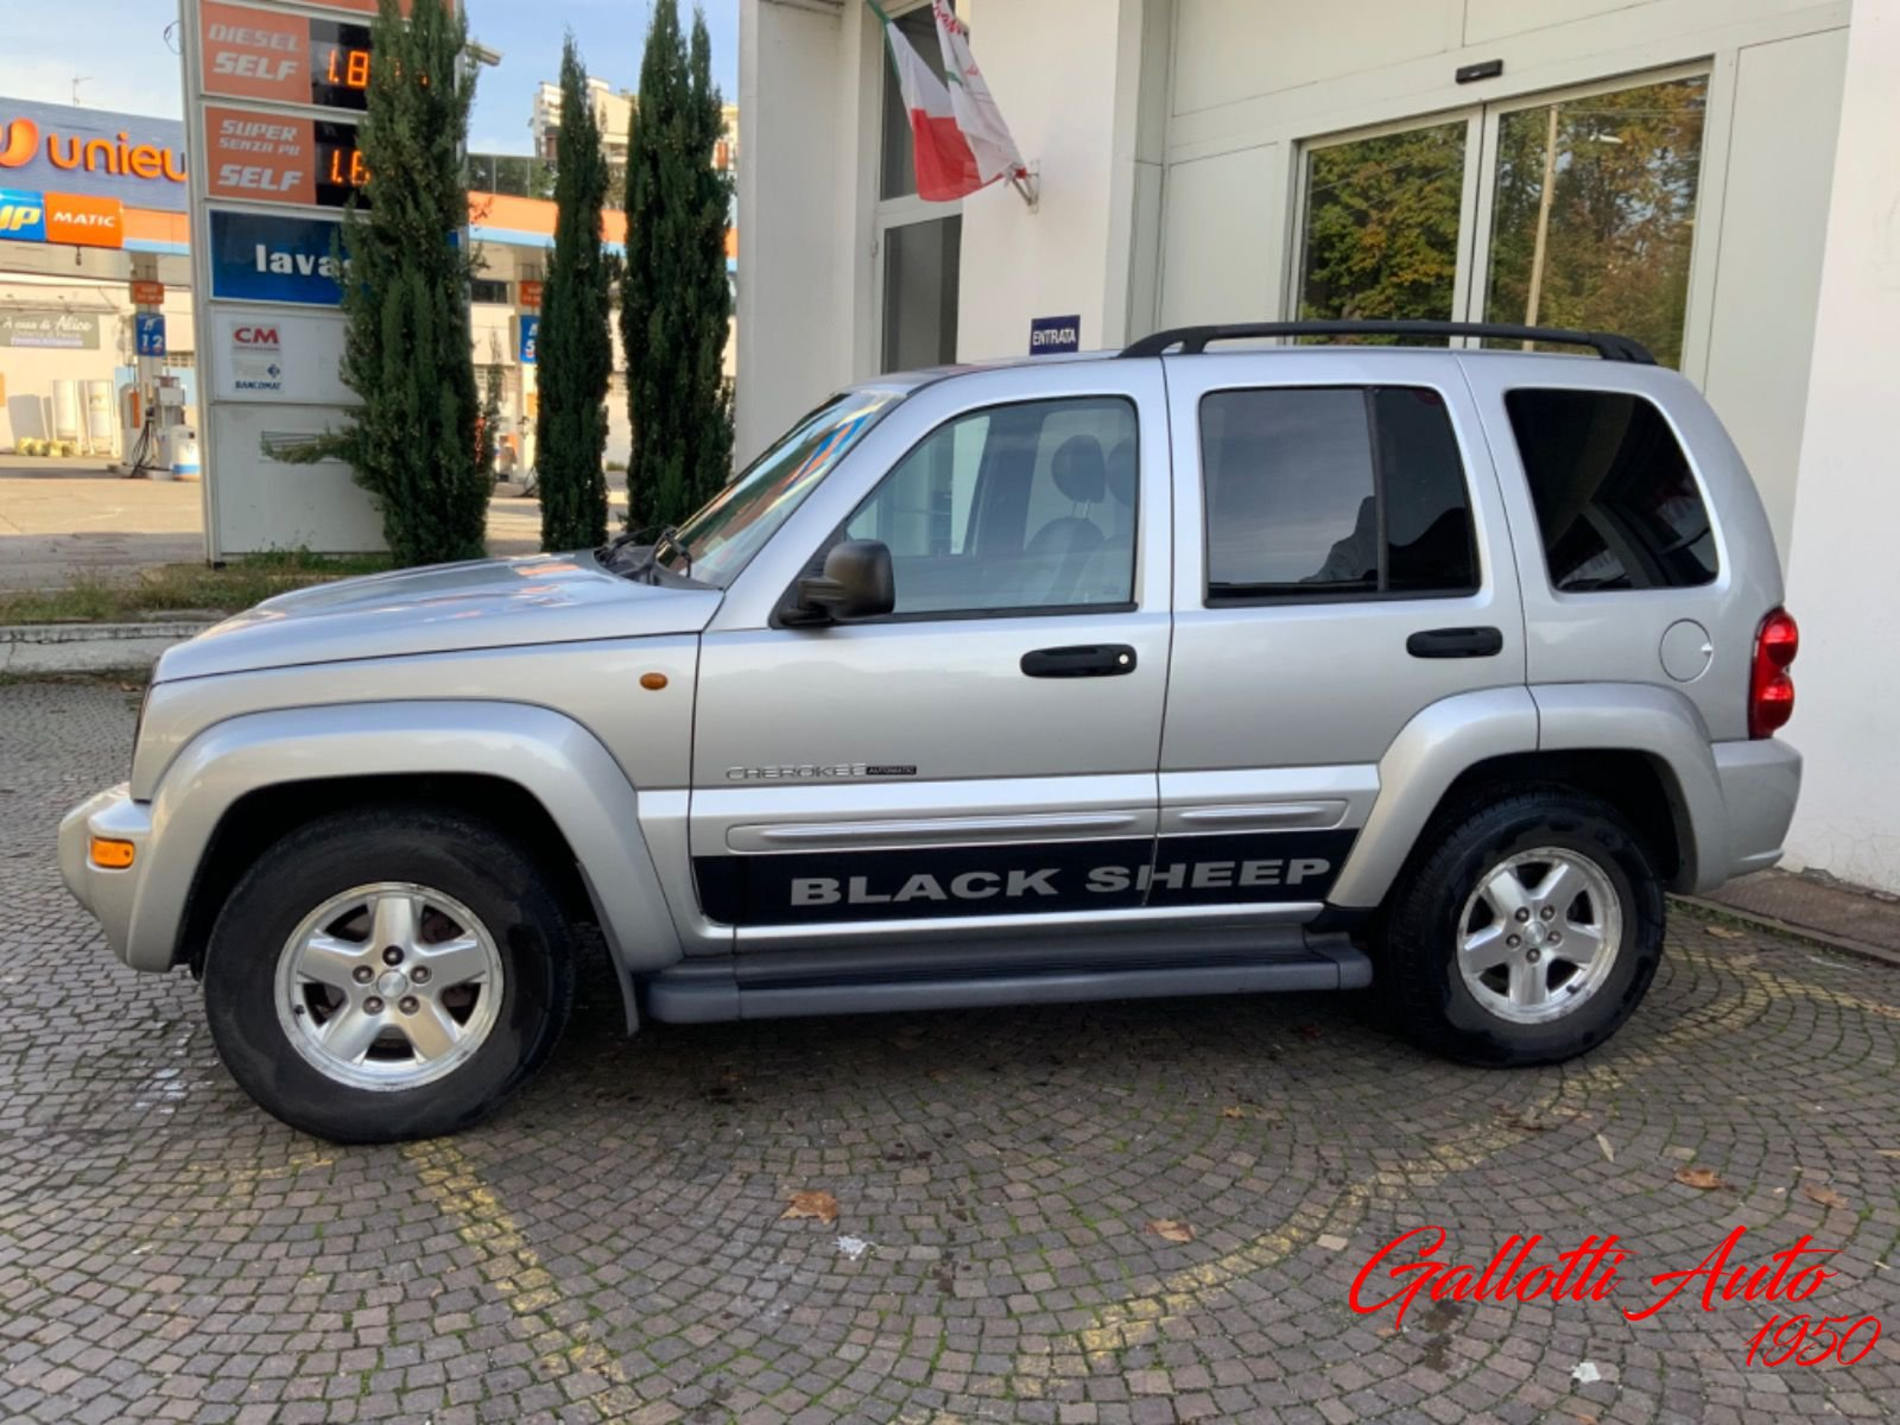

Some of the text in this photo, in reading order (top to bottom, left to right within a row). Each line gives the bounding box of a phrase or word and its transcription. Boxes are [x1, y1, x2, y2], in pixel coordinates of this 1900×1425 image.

[208, 23, 299, 50] DIESEL
[212, 51, 298, 82] SELF
[219, 119, 298, 142] SUPER
[218, 136, 274, 154] SENZA
[217, 163, 303, 191] SELF
[53, 211, 116, 228] MATIC
[233, 327, 279, 344] CM
[1033, 328, 1077, 346] ENTRATA
[234, 380, 281, 390] BANCOMAT
[726, 763, 866, 780] CHEROKEE
[790, 858, 1331, 906] BLACK SHEEP
